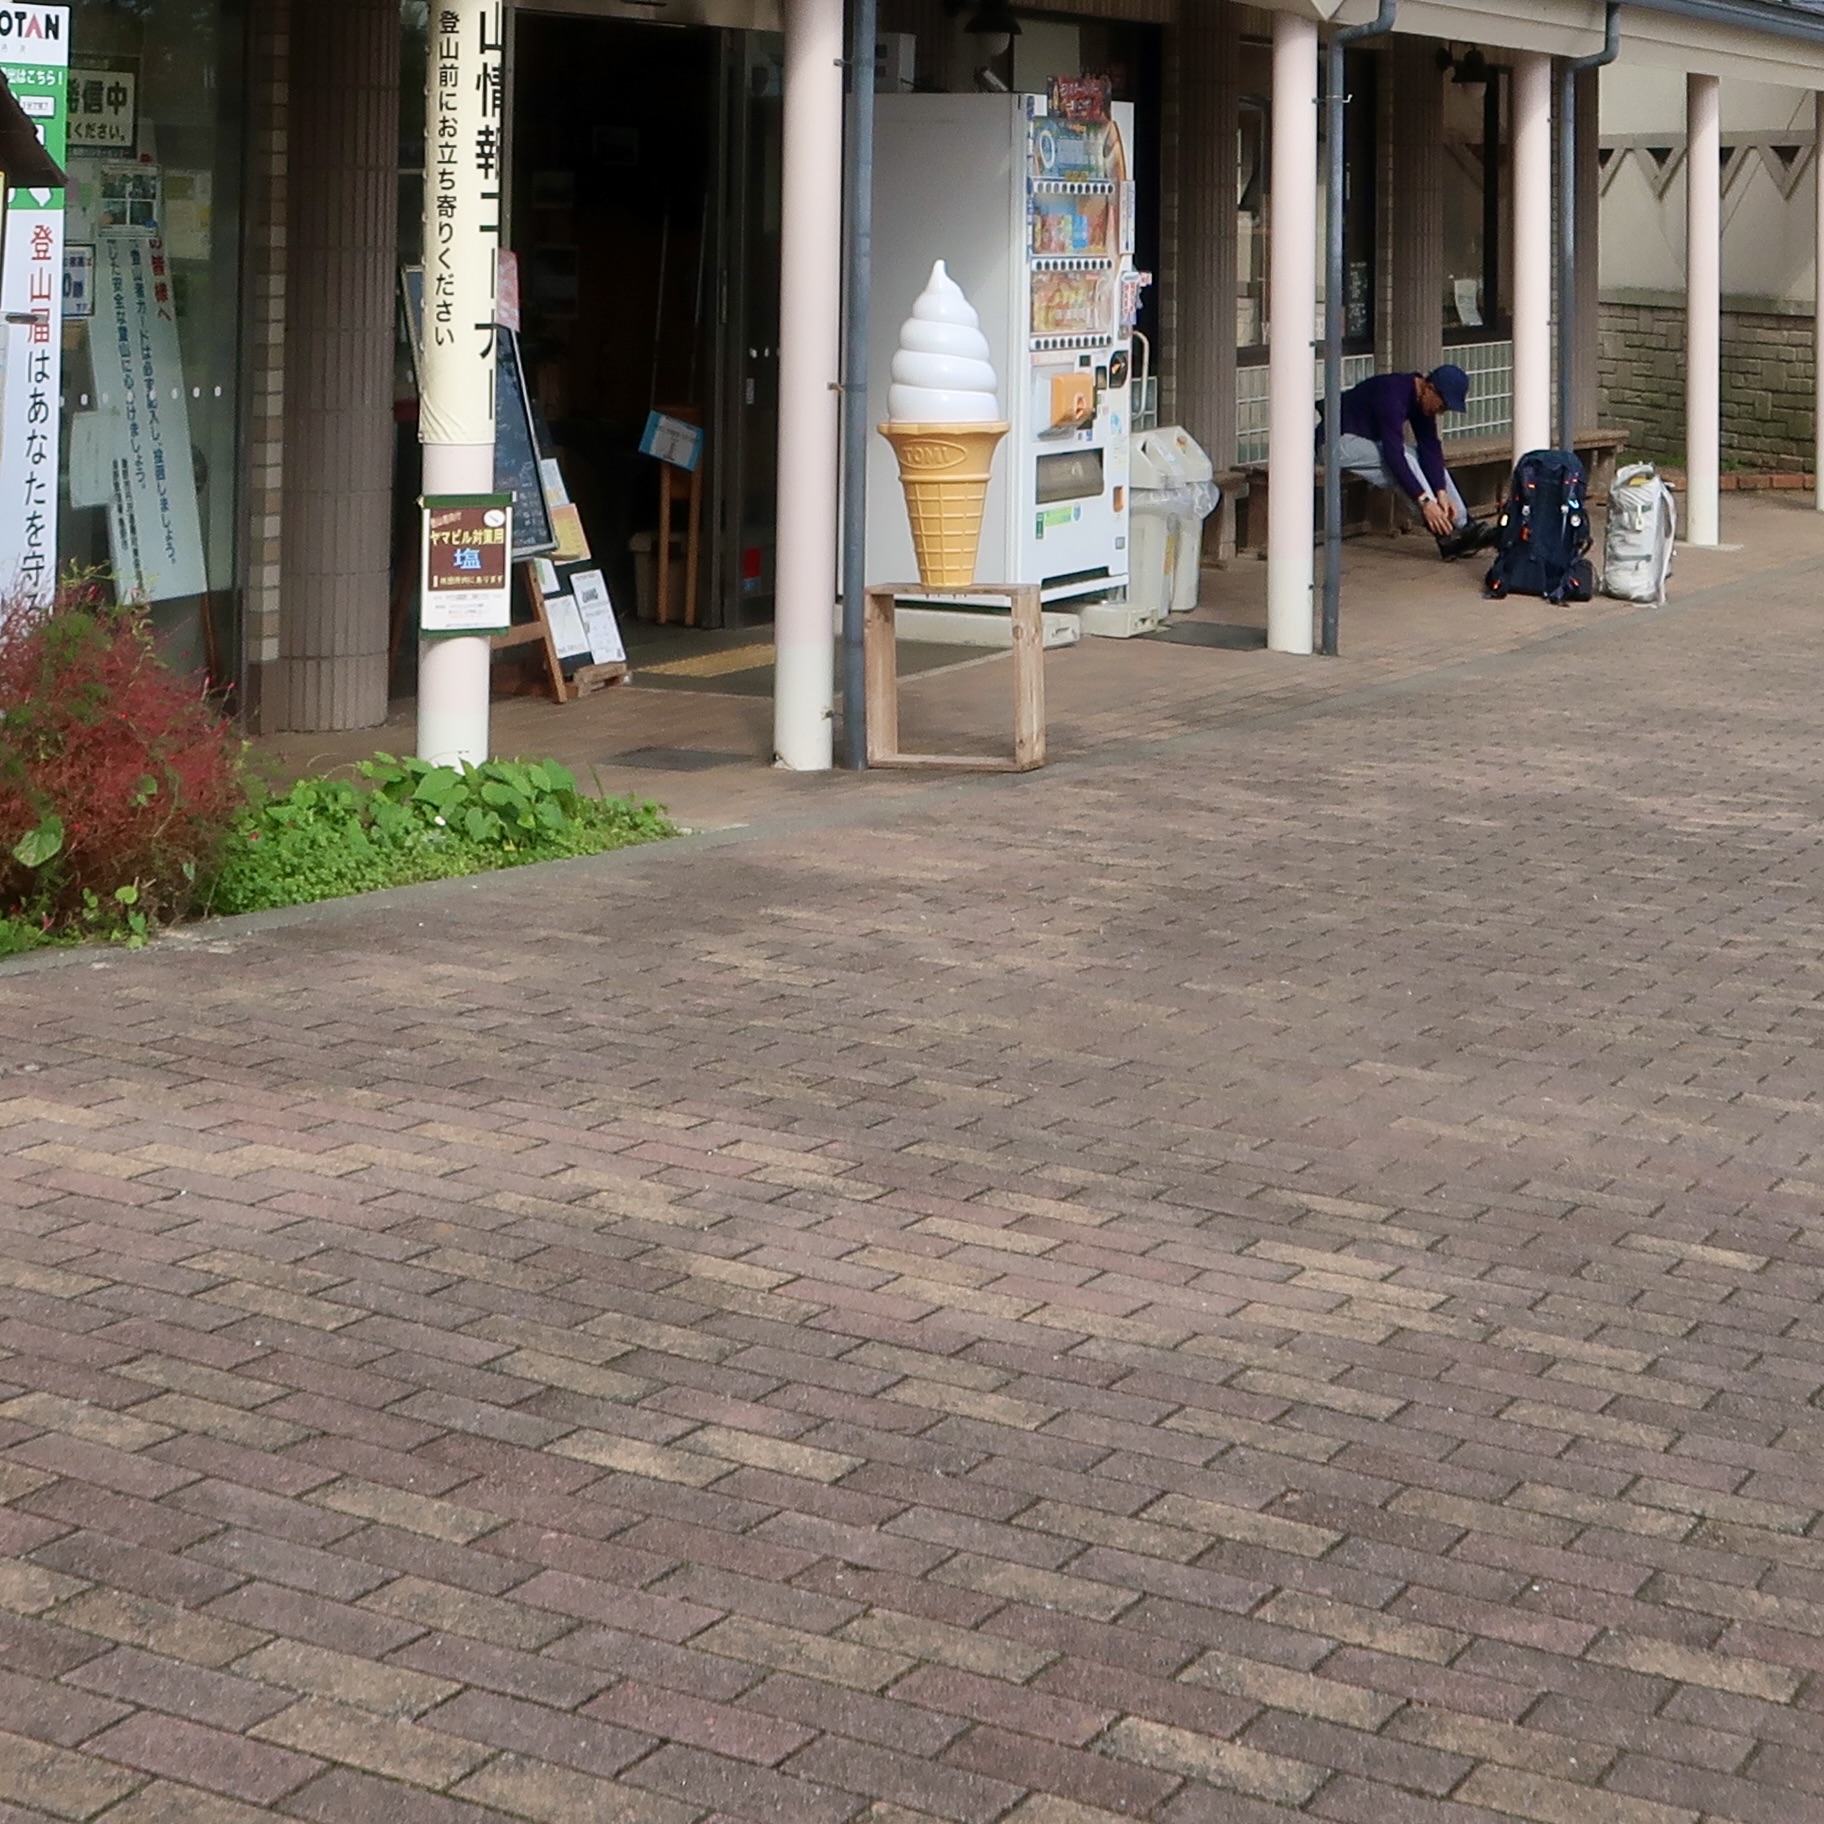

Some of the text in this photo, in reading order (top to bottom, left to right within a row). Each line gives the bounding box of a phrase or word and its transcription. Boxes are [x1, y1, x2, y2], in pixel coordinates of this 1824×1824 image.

[434, 10, 461, 347] 登山前にお立ち寄りください
[430, 528, 505, 545] ヤマビル対策用
[453, 547, 482, 570] 塩
